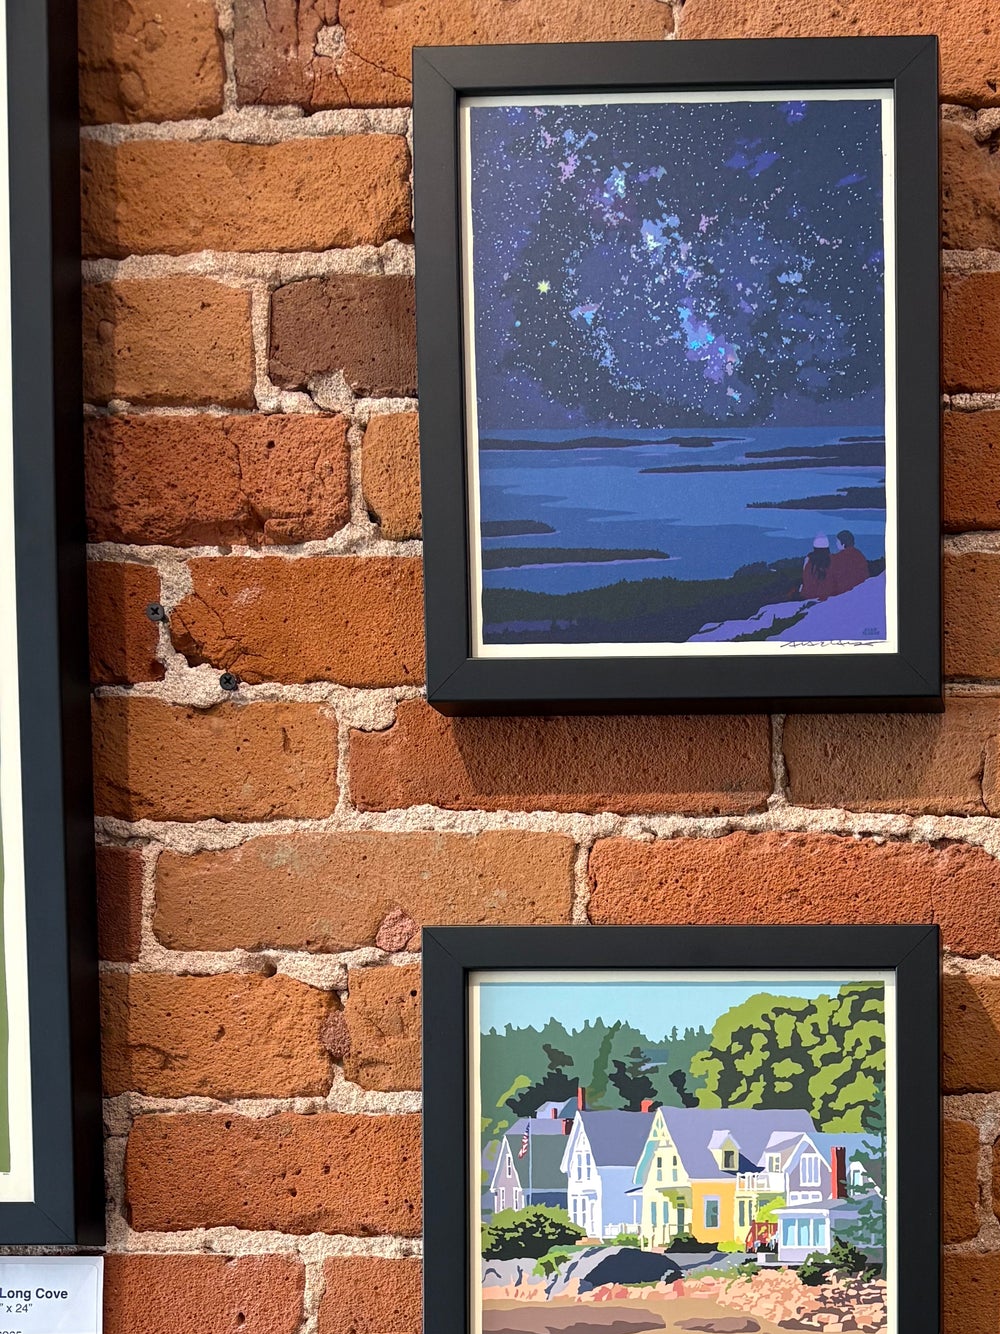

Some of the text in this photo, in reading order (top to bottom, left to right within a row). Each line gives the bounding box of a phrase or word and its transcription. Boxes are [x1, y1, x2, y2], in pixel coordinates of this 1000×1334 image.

[0, 1287, 69, 1301] Long Cove
[6, 1303, 33, 1313] x 24"
